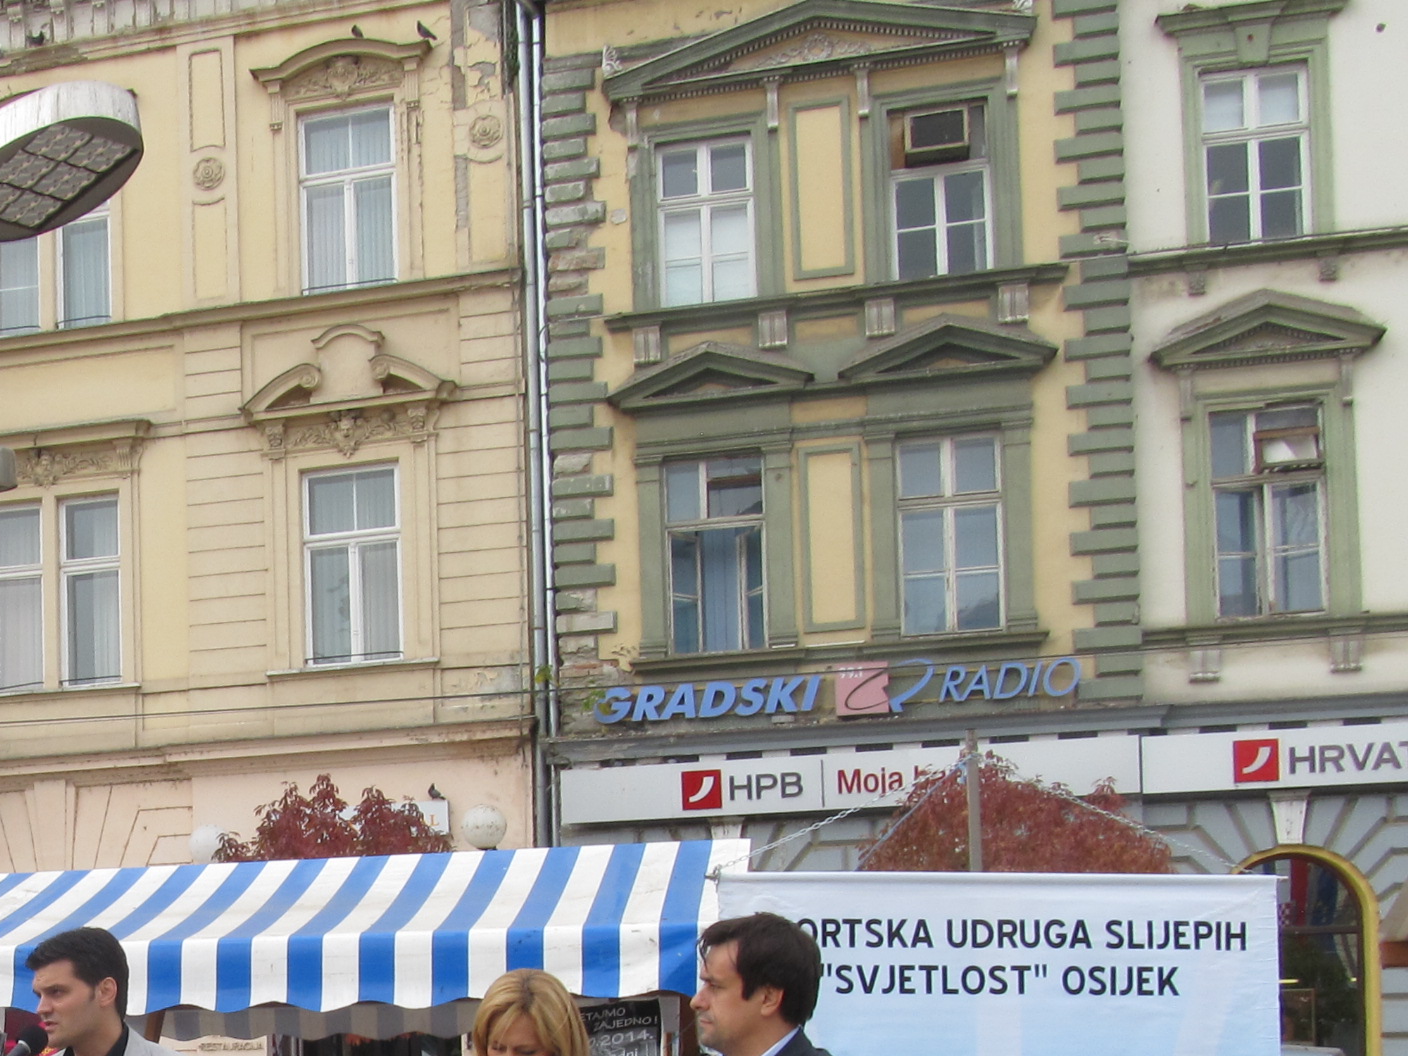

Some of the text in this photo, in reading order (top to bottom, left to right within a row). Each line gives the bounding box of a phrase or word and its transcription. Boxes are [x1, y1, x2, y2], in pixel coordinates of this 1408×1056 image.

[938, 657, 1082, 703] RADIO
[595, 674, 821, 724] GRADSKI
[728, 771, 804, 802] HPB
[837, 767, 904, 798] Moja
[797, 918, 1248, 952] ORTSKA UDRUGA SLIJEPIH
[821, 963, 1180, 997] "SVJETLOST" OSIJEK
[588, 1029, 654, 1049] 0.2014.
